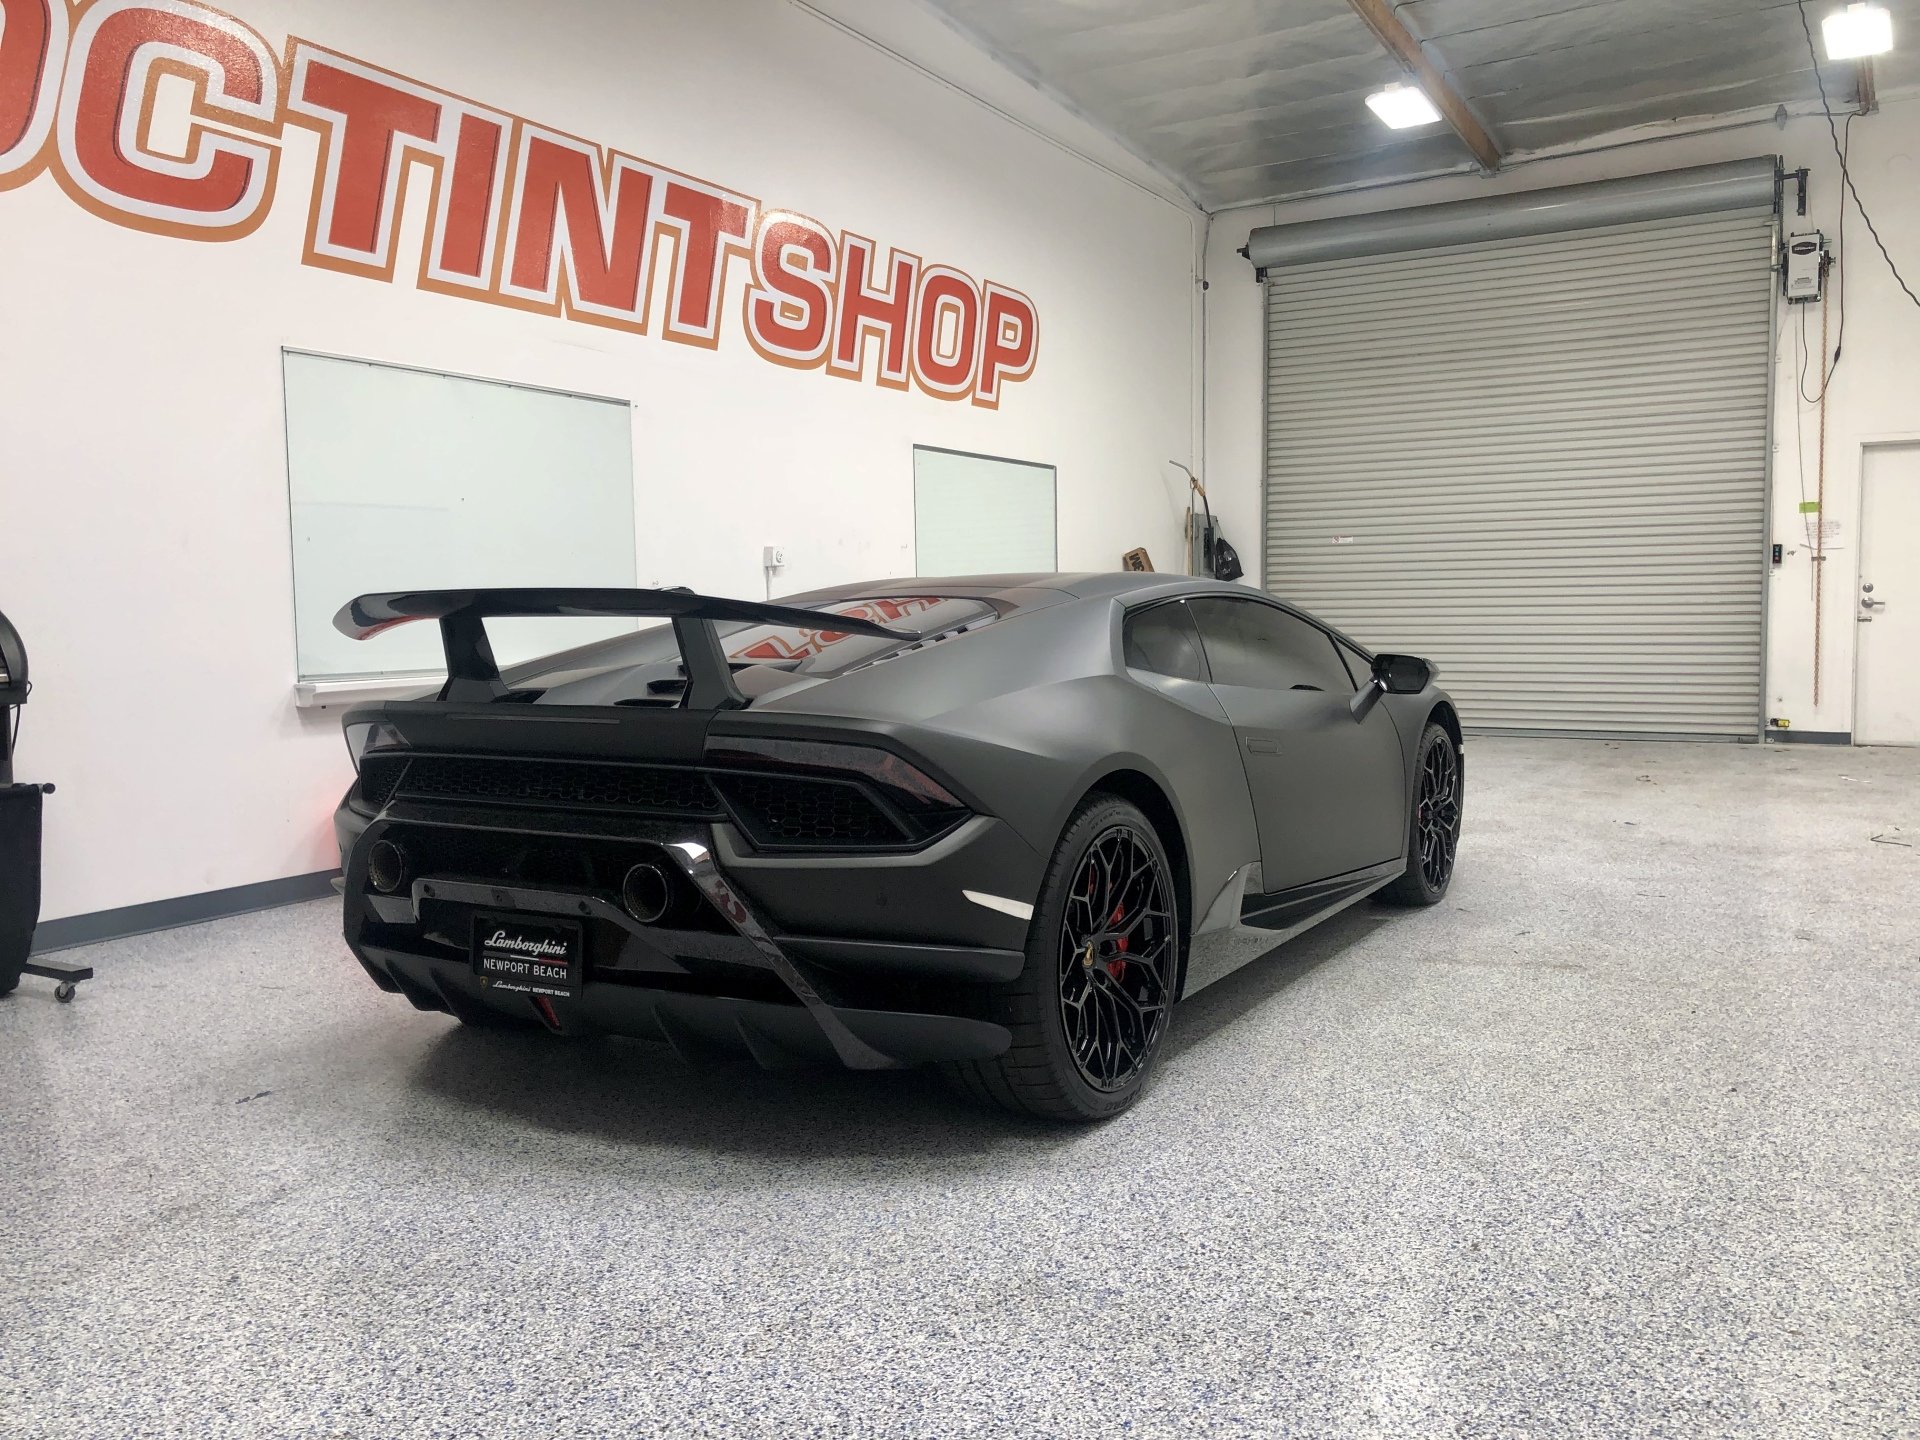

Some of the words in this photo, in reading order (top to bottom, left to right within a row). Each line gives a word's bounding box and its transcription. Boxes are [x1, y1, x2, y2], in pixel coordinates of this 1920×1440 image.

[484, 930, 567, 955] Lamborghini
[483, 958, 530, 974] NEWPORT
[533, 964, 567, 979] BEACH
[492, 980, 532, 992] Lamborghini
[532, 987, 554, 995] NEWPORT
